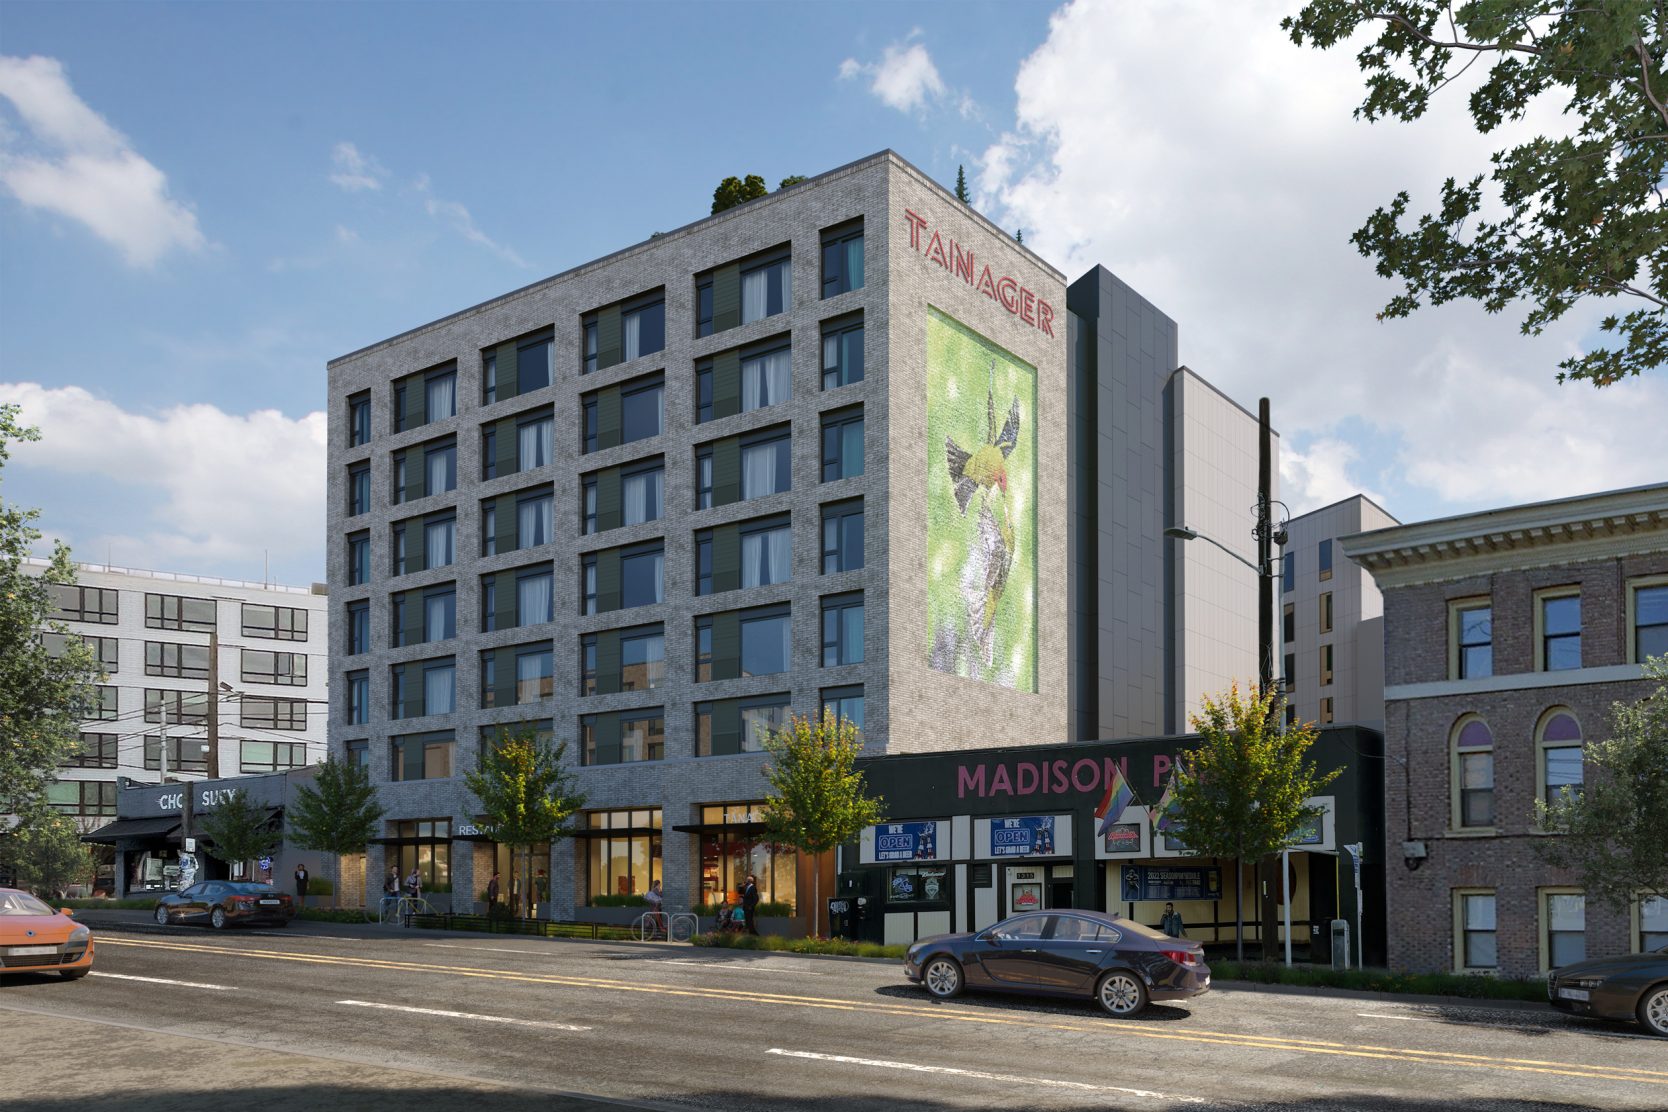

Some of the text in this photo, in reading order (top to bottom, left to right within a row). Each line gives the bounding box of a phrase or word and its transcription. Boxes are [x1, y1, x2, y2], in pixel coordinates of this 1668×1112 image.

[905, 208, 1055, 338] TANAGER
[957, 756, 1128, 799] MADISON
[160, 793, 183, 810] CHO
[880, 836, 911, 849] OPEN
[997, 831, 1028, 842] OPEN
